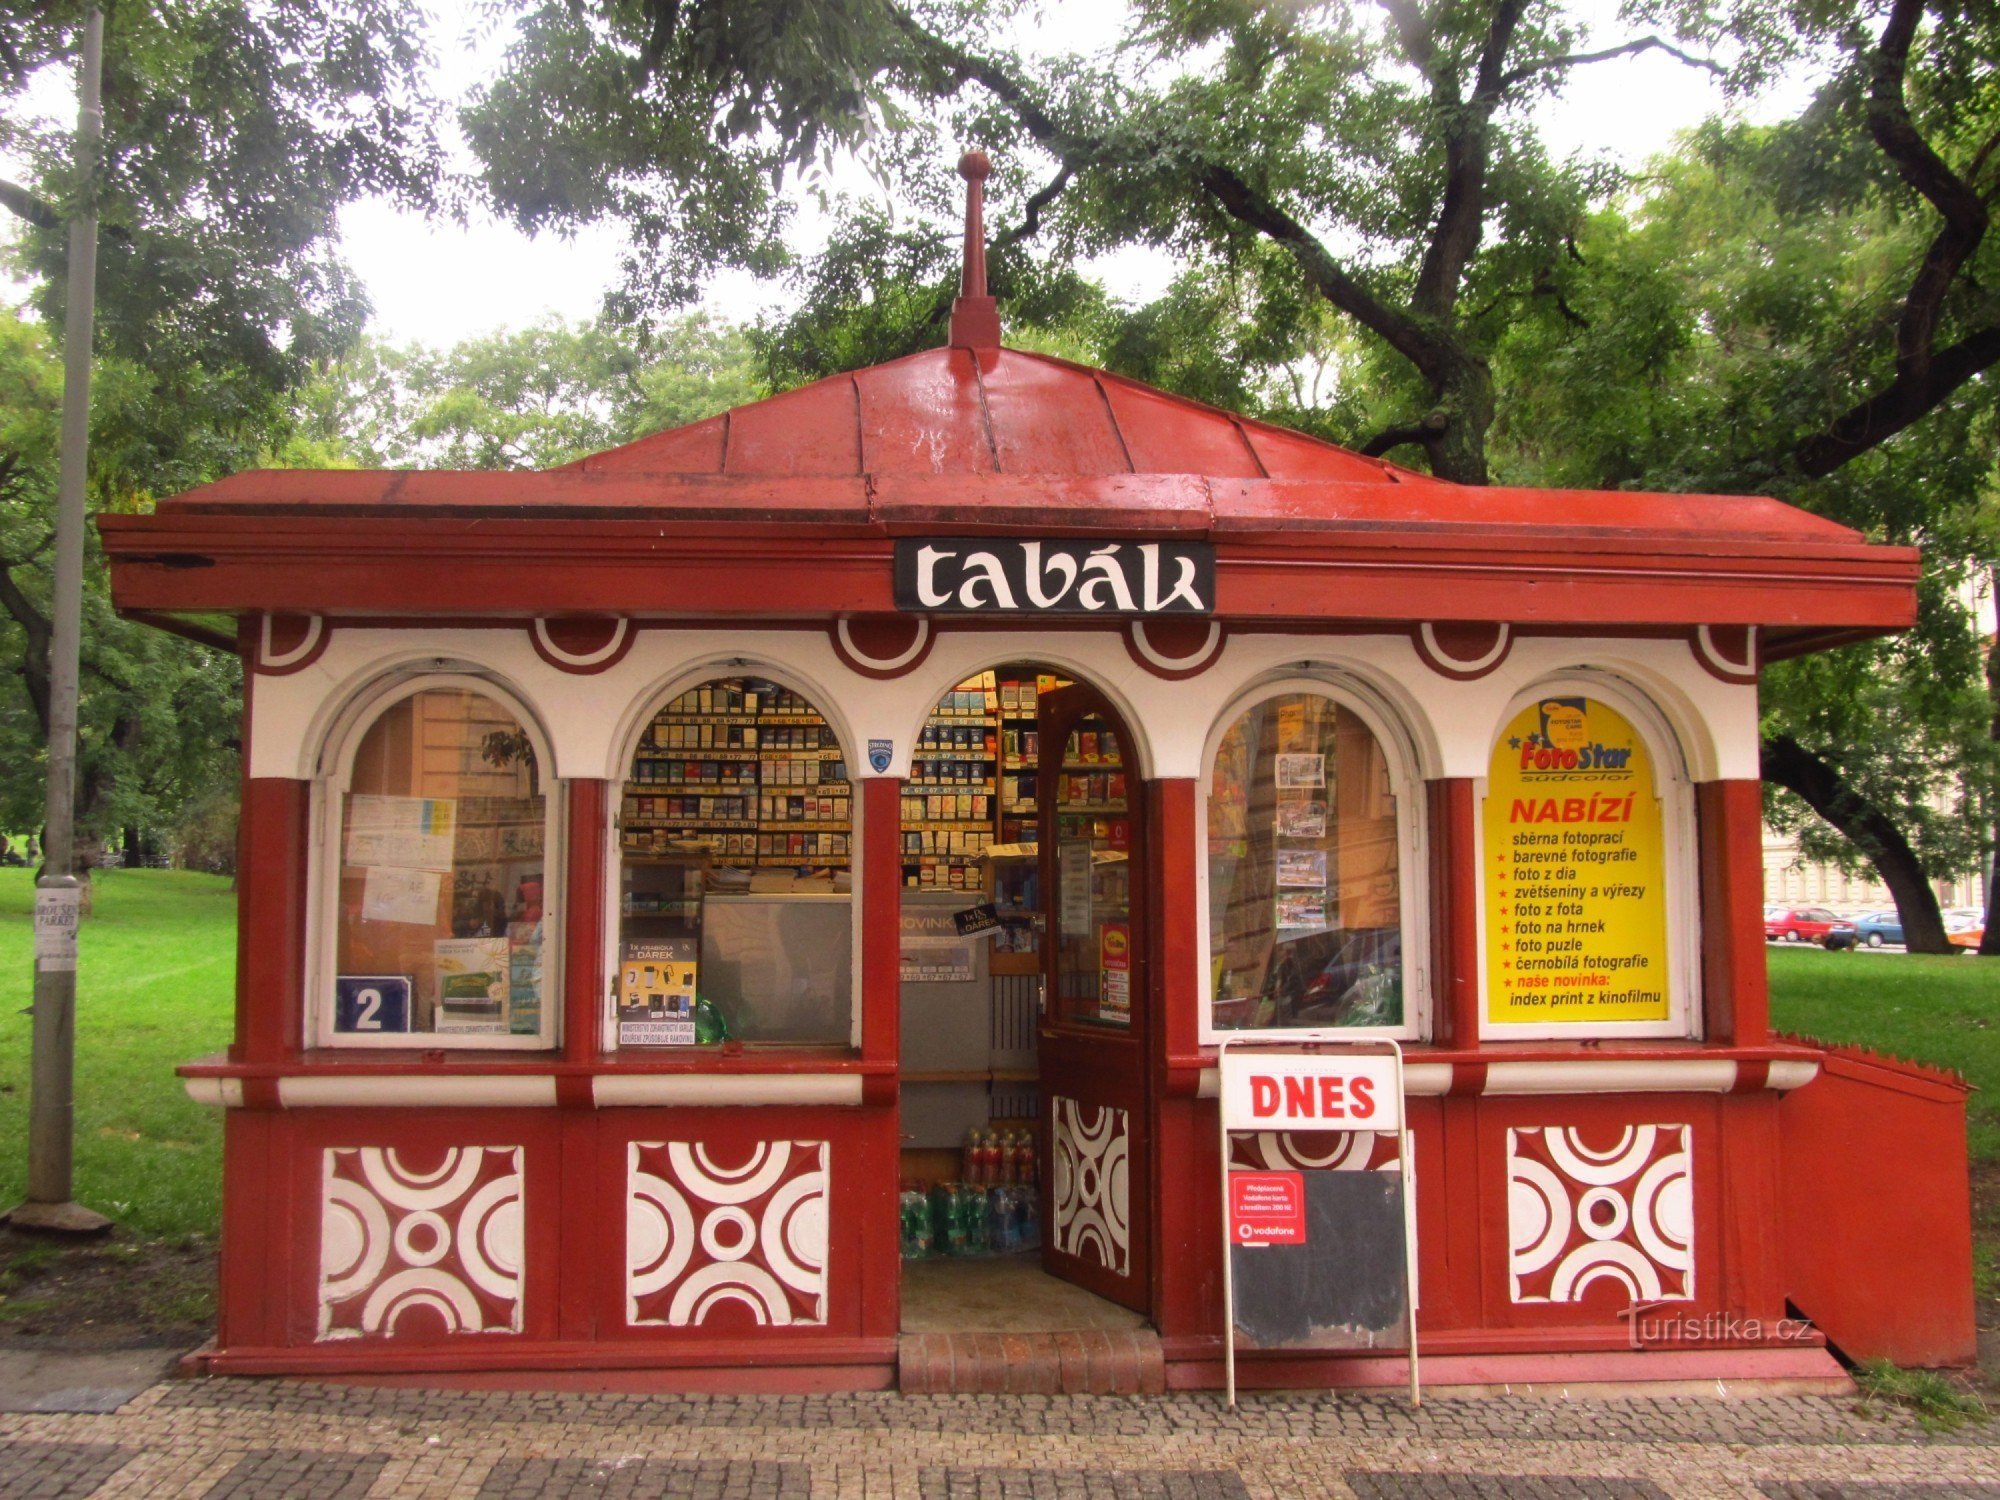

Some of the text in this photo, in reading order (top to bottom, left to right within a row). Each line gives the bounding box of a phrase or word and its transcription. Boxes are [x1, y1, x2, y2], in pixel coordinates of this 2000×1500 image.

[917, 541, 1205, 611] tabák
[1520, 742, 1632, 770] FotoStar
[1509, 791, 1638, 823] NABÍZÍ
[1512, 830, 1625, 847] sběrna fotoprací
[1513, 848, 1637, 864] barevné fotografie
[1514, 866, 1576, 881] foto z dia
[1514, 884, 1646, 900] zvětšeniny a výřezy
[1514, 902, 1583, 916] foto z fota
[1516, 920, 1606, 934] foto na hrnek
[1516, 938, 1582, 954] foto puzle
[637, 950, 673, 959] DÁREK
[1516, 954, 1648, 971] černobílá fotografie
[1517, 972, 1610, 988] naše novinka:
[1510, 990, 1661, 1008] index print z kinofilmu
[356, 988, 382, 1029] 2
[1250, 1076, 1376, 1119] DNES
[1253, 1226, 1295, 1236] vodafone
